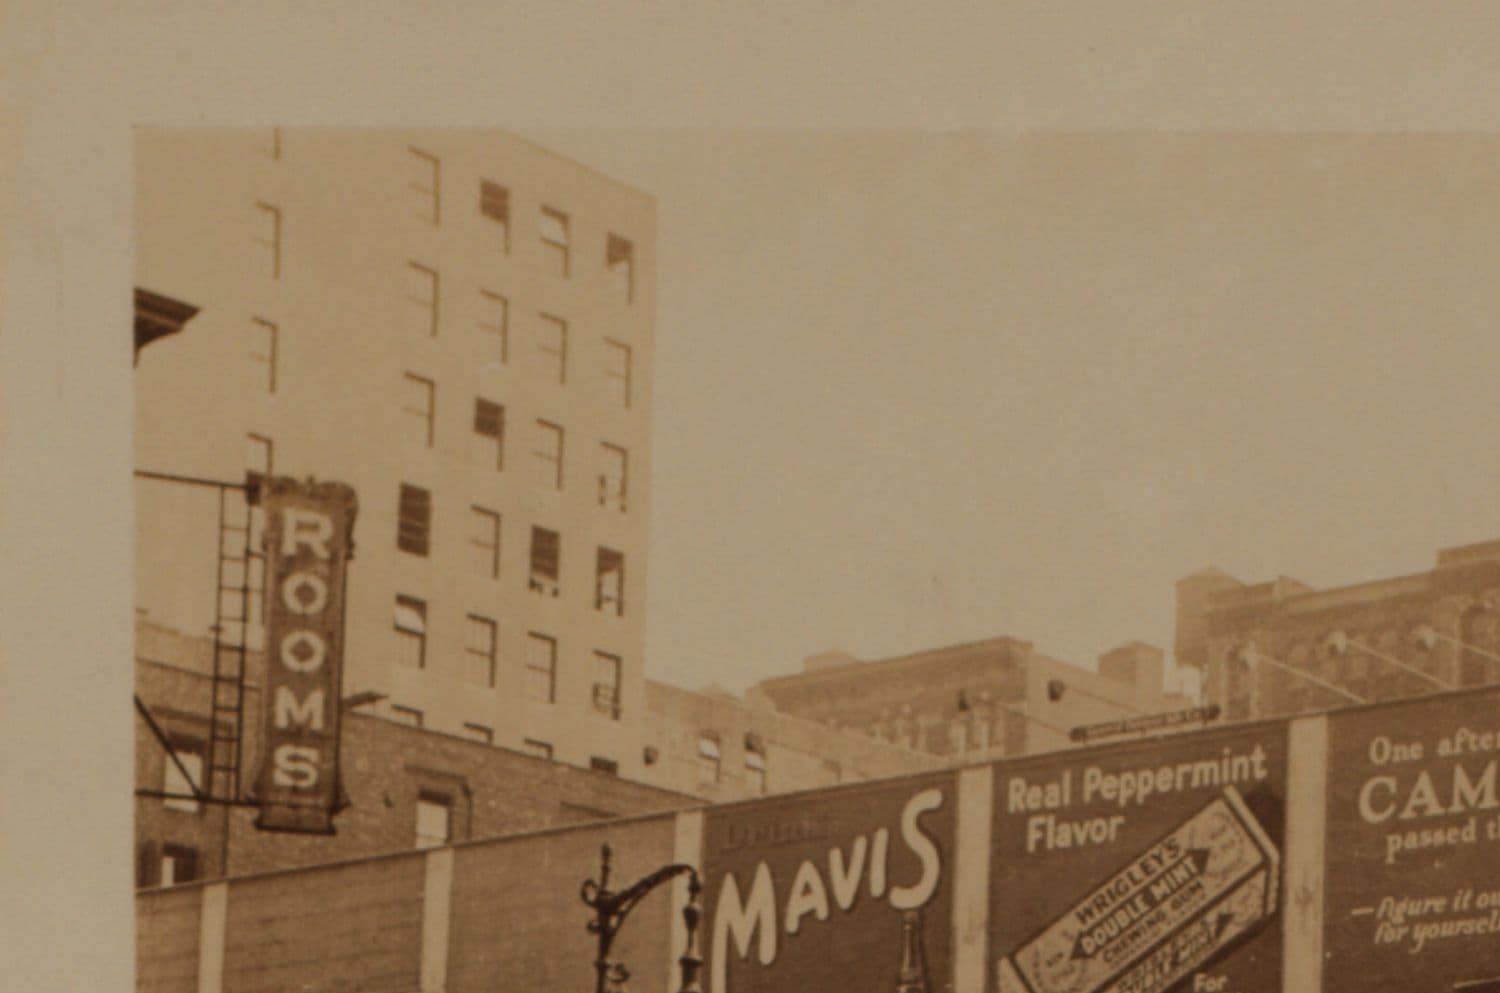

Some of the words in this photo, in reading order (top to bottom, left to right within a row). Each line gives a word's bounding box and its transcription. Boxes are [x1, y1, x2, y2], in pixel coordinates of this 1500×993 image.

[271, 508, 336, 792] ROOMS
[1369, 737, 1423, 766] One
[1008, 771, 1071, 813] Real
[1083, 745, 1269, 808] Peppermint
[1027, 815, 1125, 853] Flavor
[1385, 818, 1477, 865] passed
[1081, 894, 1151, 954] DOUBLE
[1149, 856, 1200, 901] MINT
[1453, 889, 1472, 913] it
[1374, 919, 1409, 946] for
[1193, 972, 1228, 993] For
